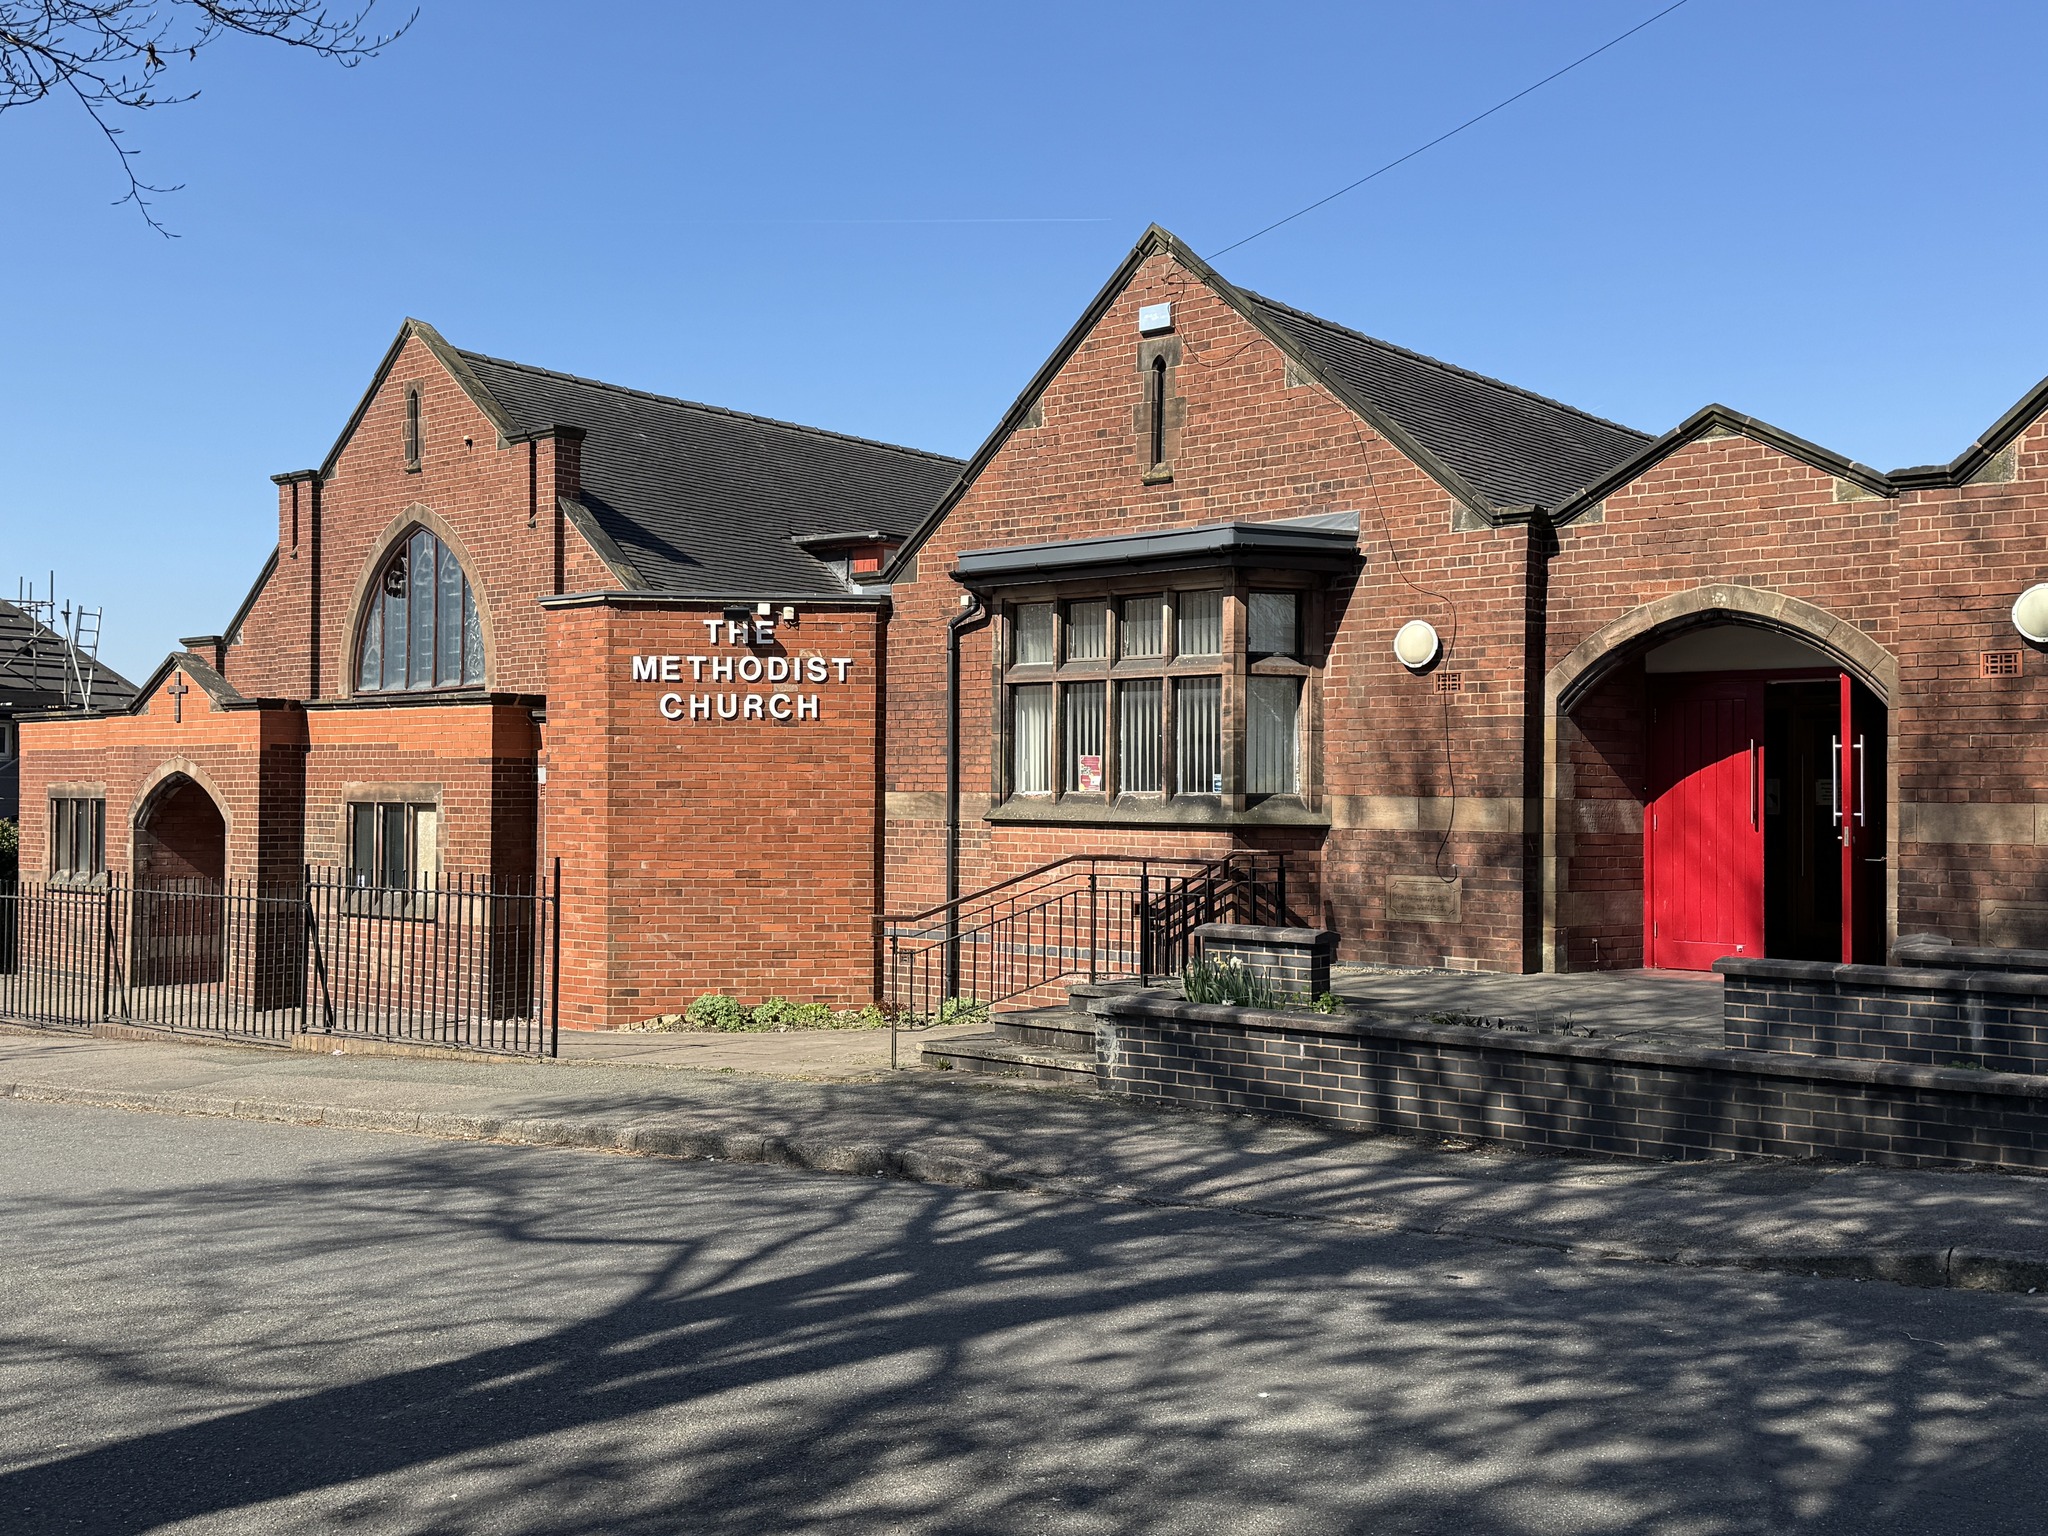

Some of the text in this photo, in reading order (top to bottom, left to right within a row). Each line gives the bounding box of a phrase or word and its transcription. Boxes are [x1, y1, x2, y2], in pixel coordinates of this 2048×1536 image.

[703, 619, 774, 645] THE
[632, 655, 853, 682] METHODIST
[660, 693, 818, 719] CHURCH
